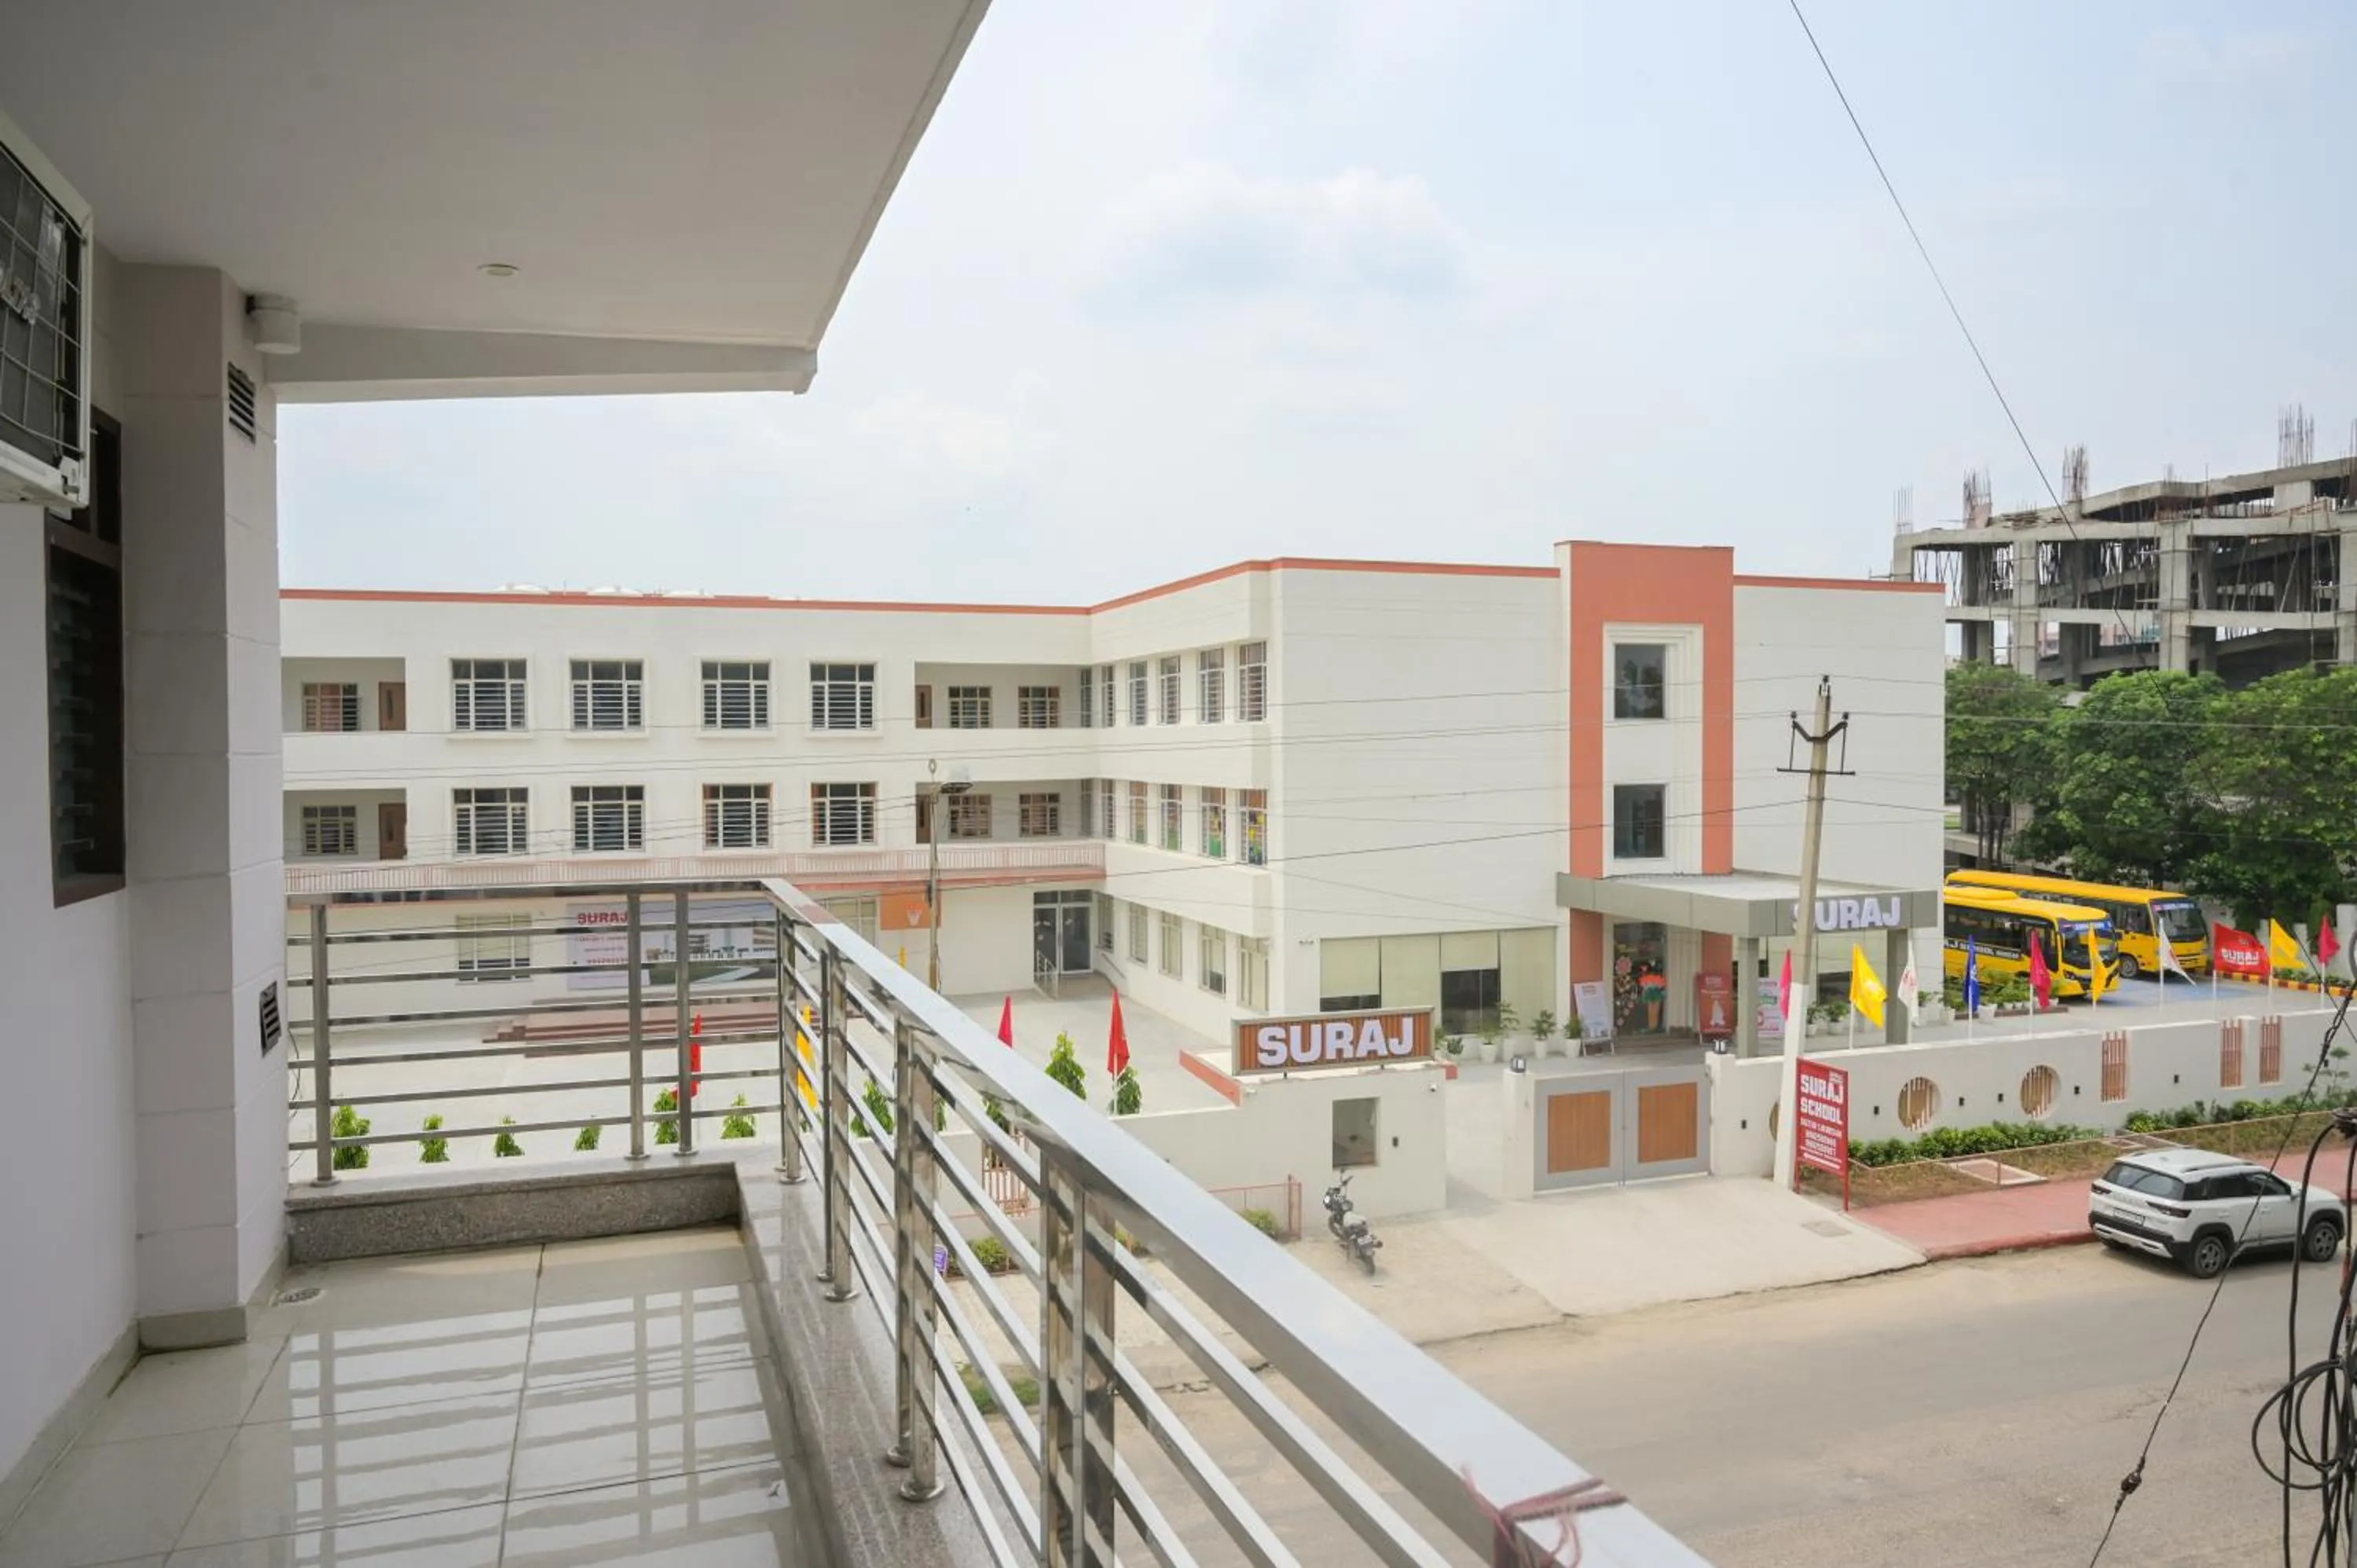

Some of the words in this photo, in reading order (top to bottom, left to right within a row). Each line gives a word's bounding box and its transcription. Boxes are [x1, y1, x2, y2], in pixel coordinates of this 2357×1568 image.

[1790, 896, 1901, 932] URAJ
[1257, 1017, 1413, 1066] SURAJ
[1801, 1074, 1843, 1105] SURAJ
[1801, 1097, 1843, 1124] SCHOOL
